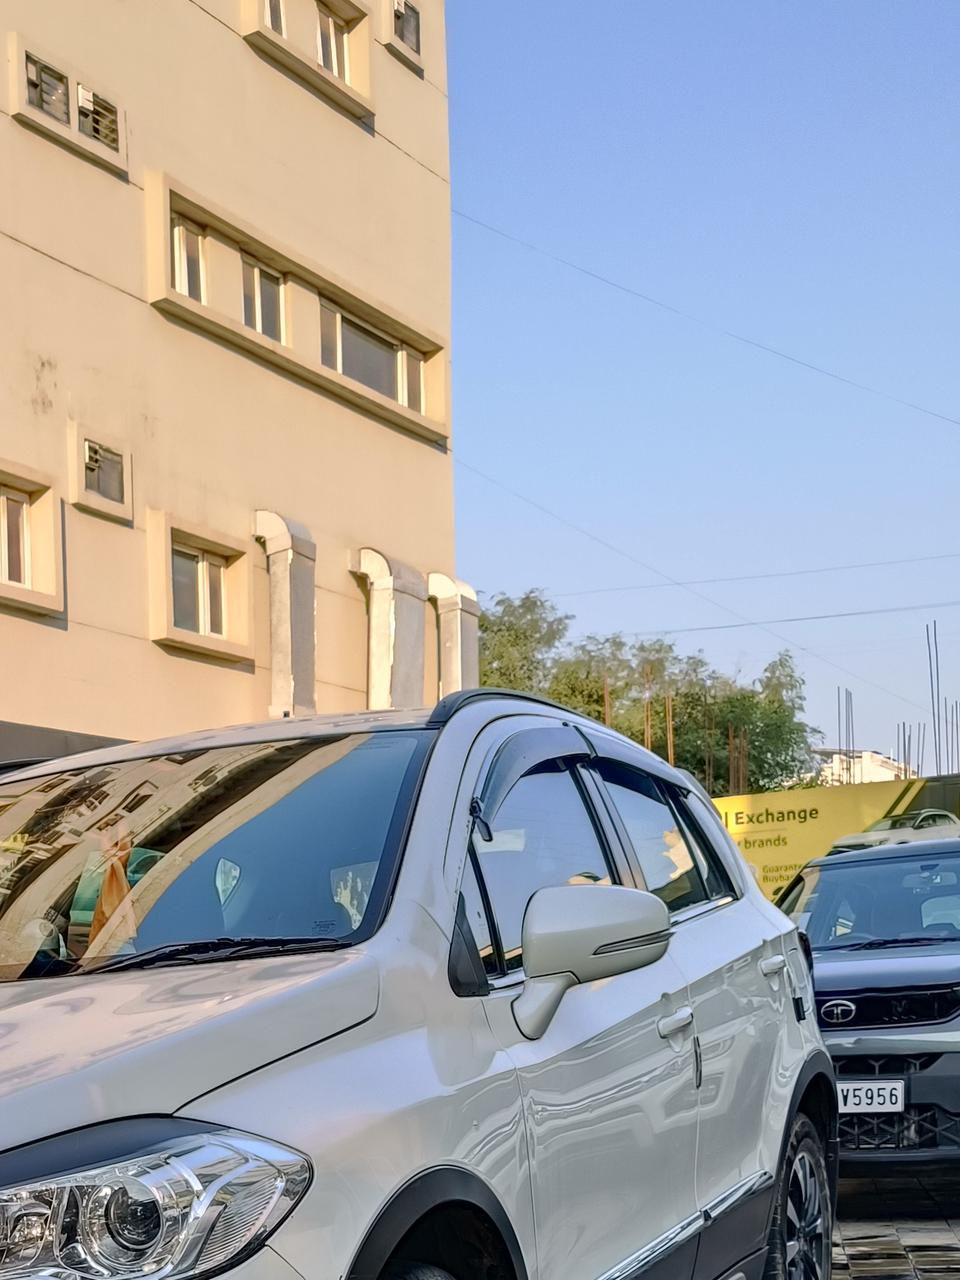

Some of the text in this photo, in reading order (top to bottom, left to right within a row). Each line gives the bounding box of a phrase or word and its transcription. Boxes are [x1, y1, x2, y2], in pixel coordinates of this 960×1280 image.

[735, 808, 819, 825] Exchange
[743, 835, 788, 849] brands
[762, 874, 793, 884] Buyba
[841, 1087, 899, 1107] V5956
